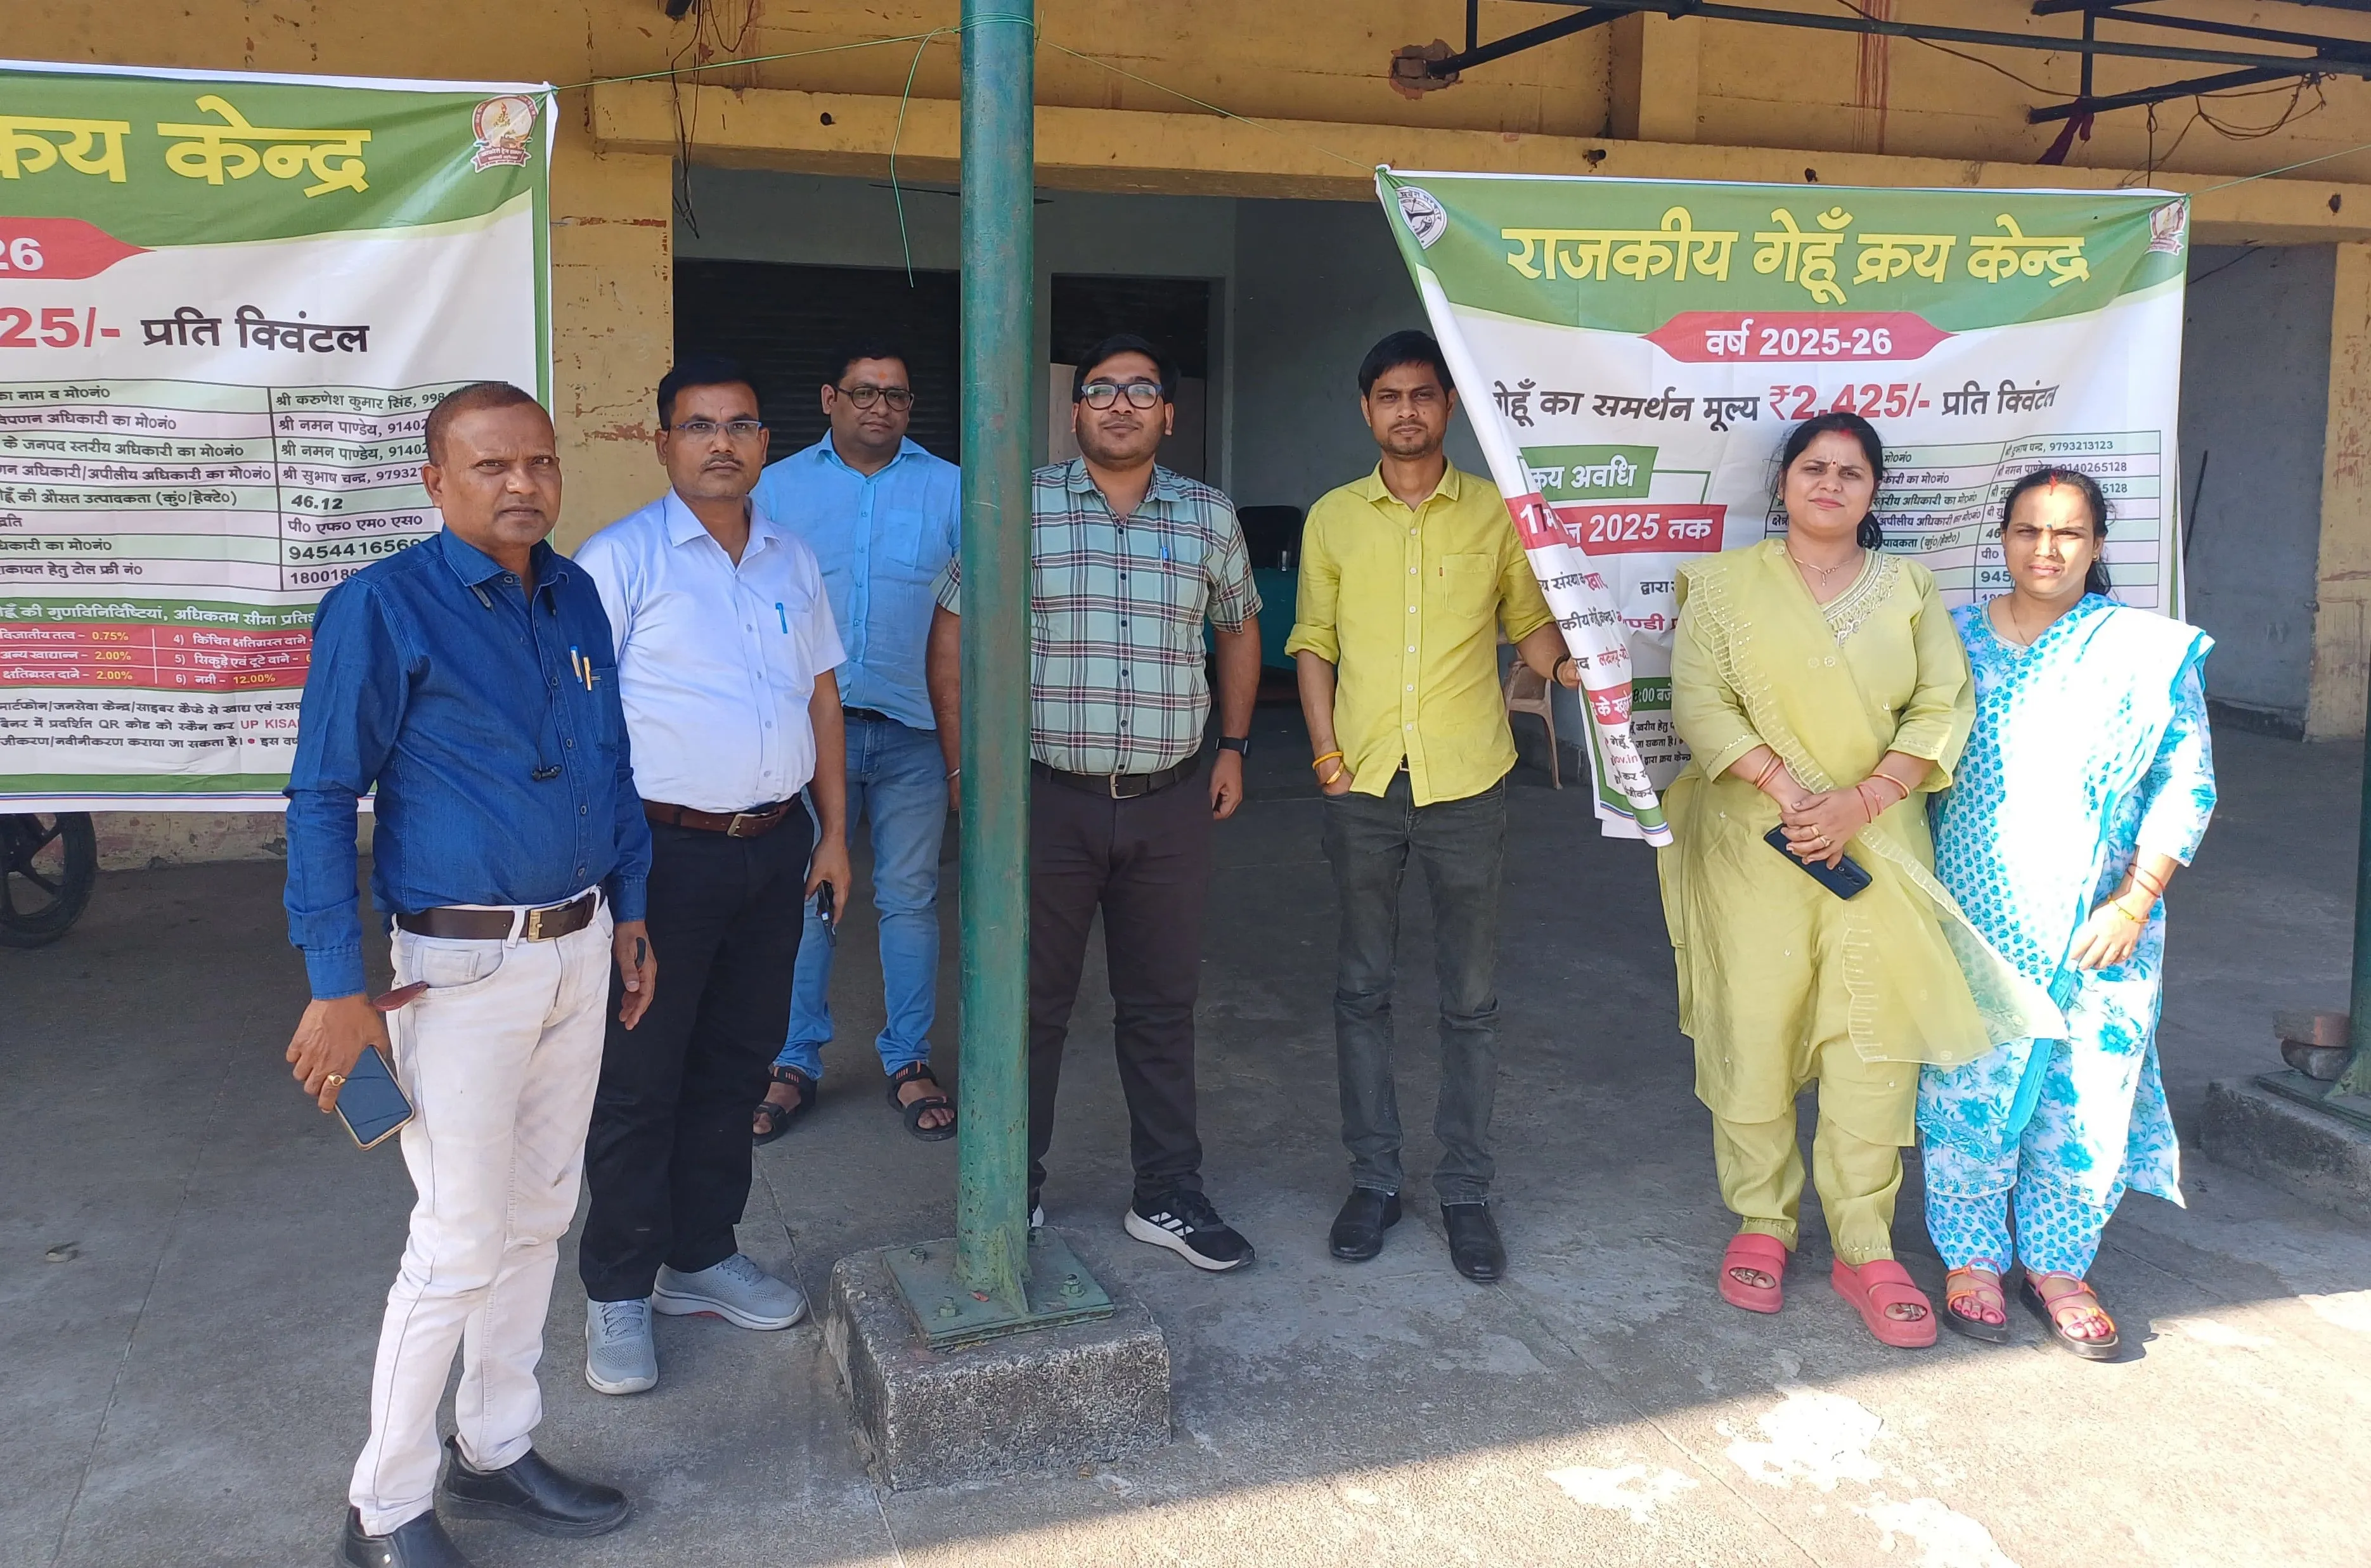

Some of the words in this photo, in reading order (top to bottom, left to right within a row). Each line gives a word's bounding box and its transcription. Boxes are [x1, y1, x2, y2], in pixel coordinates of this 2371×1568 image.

[158, 95, 371, 198] केन्द्र
[1501, 206, 1739, 282] राजकीय
[1752, 207, 1853, 305] गेहूँ
[1852, 232, 1956, 285] क्रय
[1967, 213, 2091, 288] केन्द्र
[140, 305, 222, 348] प्रति
[1705, 318, 1754, 356] वर्ष
[1760, 327, 1892, 357] 2025-26
[17, 390, 45, 401] नाम
[50, 390, 60, 400] व
[276, 392, 292, 407] श्री
[295, 390, 345, 407] करुणेश
[349, 396, 384, 411] कुमार
[388, 395, 417, 409] सिंह,
[1540, 390, 1585, 416] का
[1592, 386, 1695, 421] समर्थन
[1703, 395, 1760, 432] मूल्य
[1941, 380, 1989, 417] प्रति
[48, 411, 108, 425] अधिकारी
[113, 415, 131, 426] का
[278, 416, 295, 432] श्री
[299, 420, 334, 433] नमन
[2, 435, 18, 449] के
[70, 439, 111, 454] स्तरीय
[115, 443, 173, 457] अधिकारी
[177, 446, 195, 457] का
[281, 440, 297, 457] श्री
[300, 446, 335, 459] नमन
[2049, 440, 2114, 452] 9793213123
[143, 469, 201, 481] अधिकारी
[206, 470, 224, 480] का
[283, 466, 298, 480] श्री
[302, 470, 338, 485] सुभाष
[1571, 454, 1638, 489] अवधि
[1906, 475, 1920, 485] का
[19, 488, 37, 503] की
[41, 489, 81, 504] औसत
[84, 494, 152, 504] उत्पादकता
[291, 494, 344, 511] 46.12
[1903, 494, 1942, 506] अधिकारी
[1944, 496, 1957, 506] का
[1587, 513, 1662, 543] 2025
[1668, 518, 1714, 540] तक
[44, 541, 65, 551] का
[48, 562, 69, 578] हेतु
[72, 562, 96, 575] टोल
[100, 562, 120, 575] फ्री
[1639, 581, 1669, 595] द्वारा
[20, 603, 43, 618] की
[174, 606, 240, 624] अधिकतम
[243, 610, 277, 626] सीमा
[92, 631, 129, 641] 0.75%
[173, 634, 184, 646] 4)
[94, 651, 132, 661] 2.00%
[174, 654, 186, 665] 5)
[96, 671, 133, 680] 2.00%
[176, 674, 186, 686] 6)
[194, 673, 217, 685] नमी
[233, 673, 276, 685] 12.00%
[178, 702, 205, 714] कैफे
[207, 704, 219, 715] से
[222, 704, 252, 713] खाद्य
[254, 701, 273, 714] एवं
[33, 716, 44, 728] में
[49, 717, 93, 729] प्रदर्शित
[99, 719, 120, 729] QR
[125, 717, 151, 729] कोड
[155, 719, 172, 731] को
[178, 720, 208, 731] स्कैन
[212, 721, 235, 731] कर
[240, 720, 259, 729] UP
[127, 738, 165, 747] कराया
[169, 739, 184, 748] जा
[188, 738, 224, 749] सकता
[260, 736, 280, 747] इस
